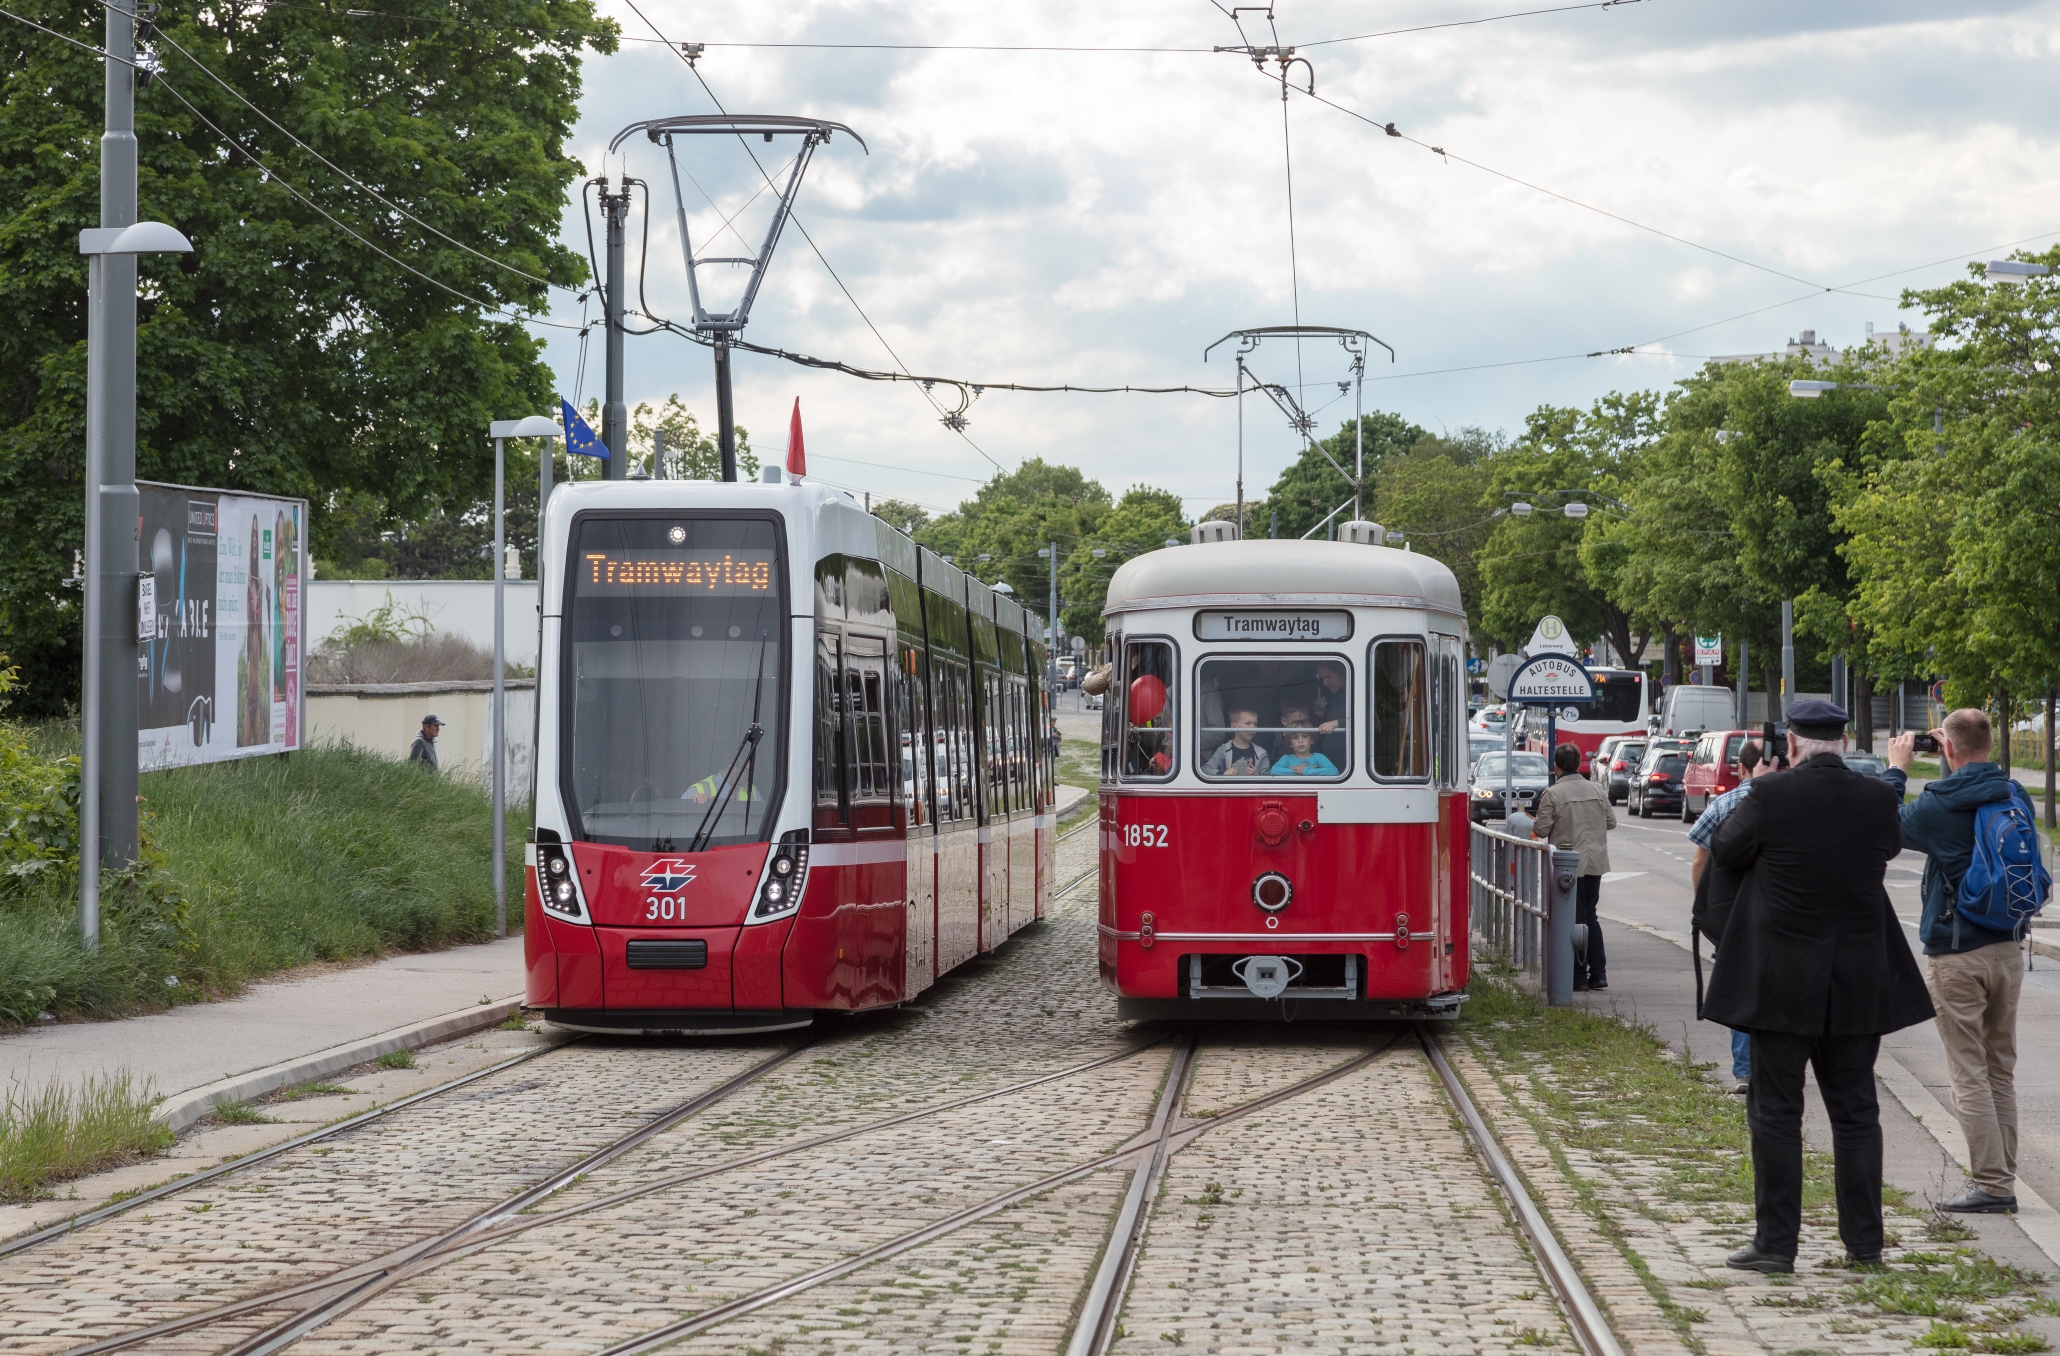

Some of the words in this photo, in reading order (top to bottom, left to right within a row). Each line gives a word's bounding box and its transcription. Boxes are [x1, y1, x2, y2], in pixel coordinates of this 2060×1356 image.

[586, 553, 769, 590] Tramwaytag
[1222, 615, 1320, 636] Tramwaytag
[1528, 660, 1578, 678] AUTOBUS
[1594, 673, 1607, 684] 71A
[1519, 685, 1586, 696] HALTESTELLE
[1565, 710, 1578, 718] 71A
[1123, 823, 1169, 848] 1852
[645, 896, 687, 921] 301
